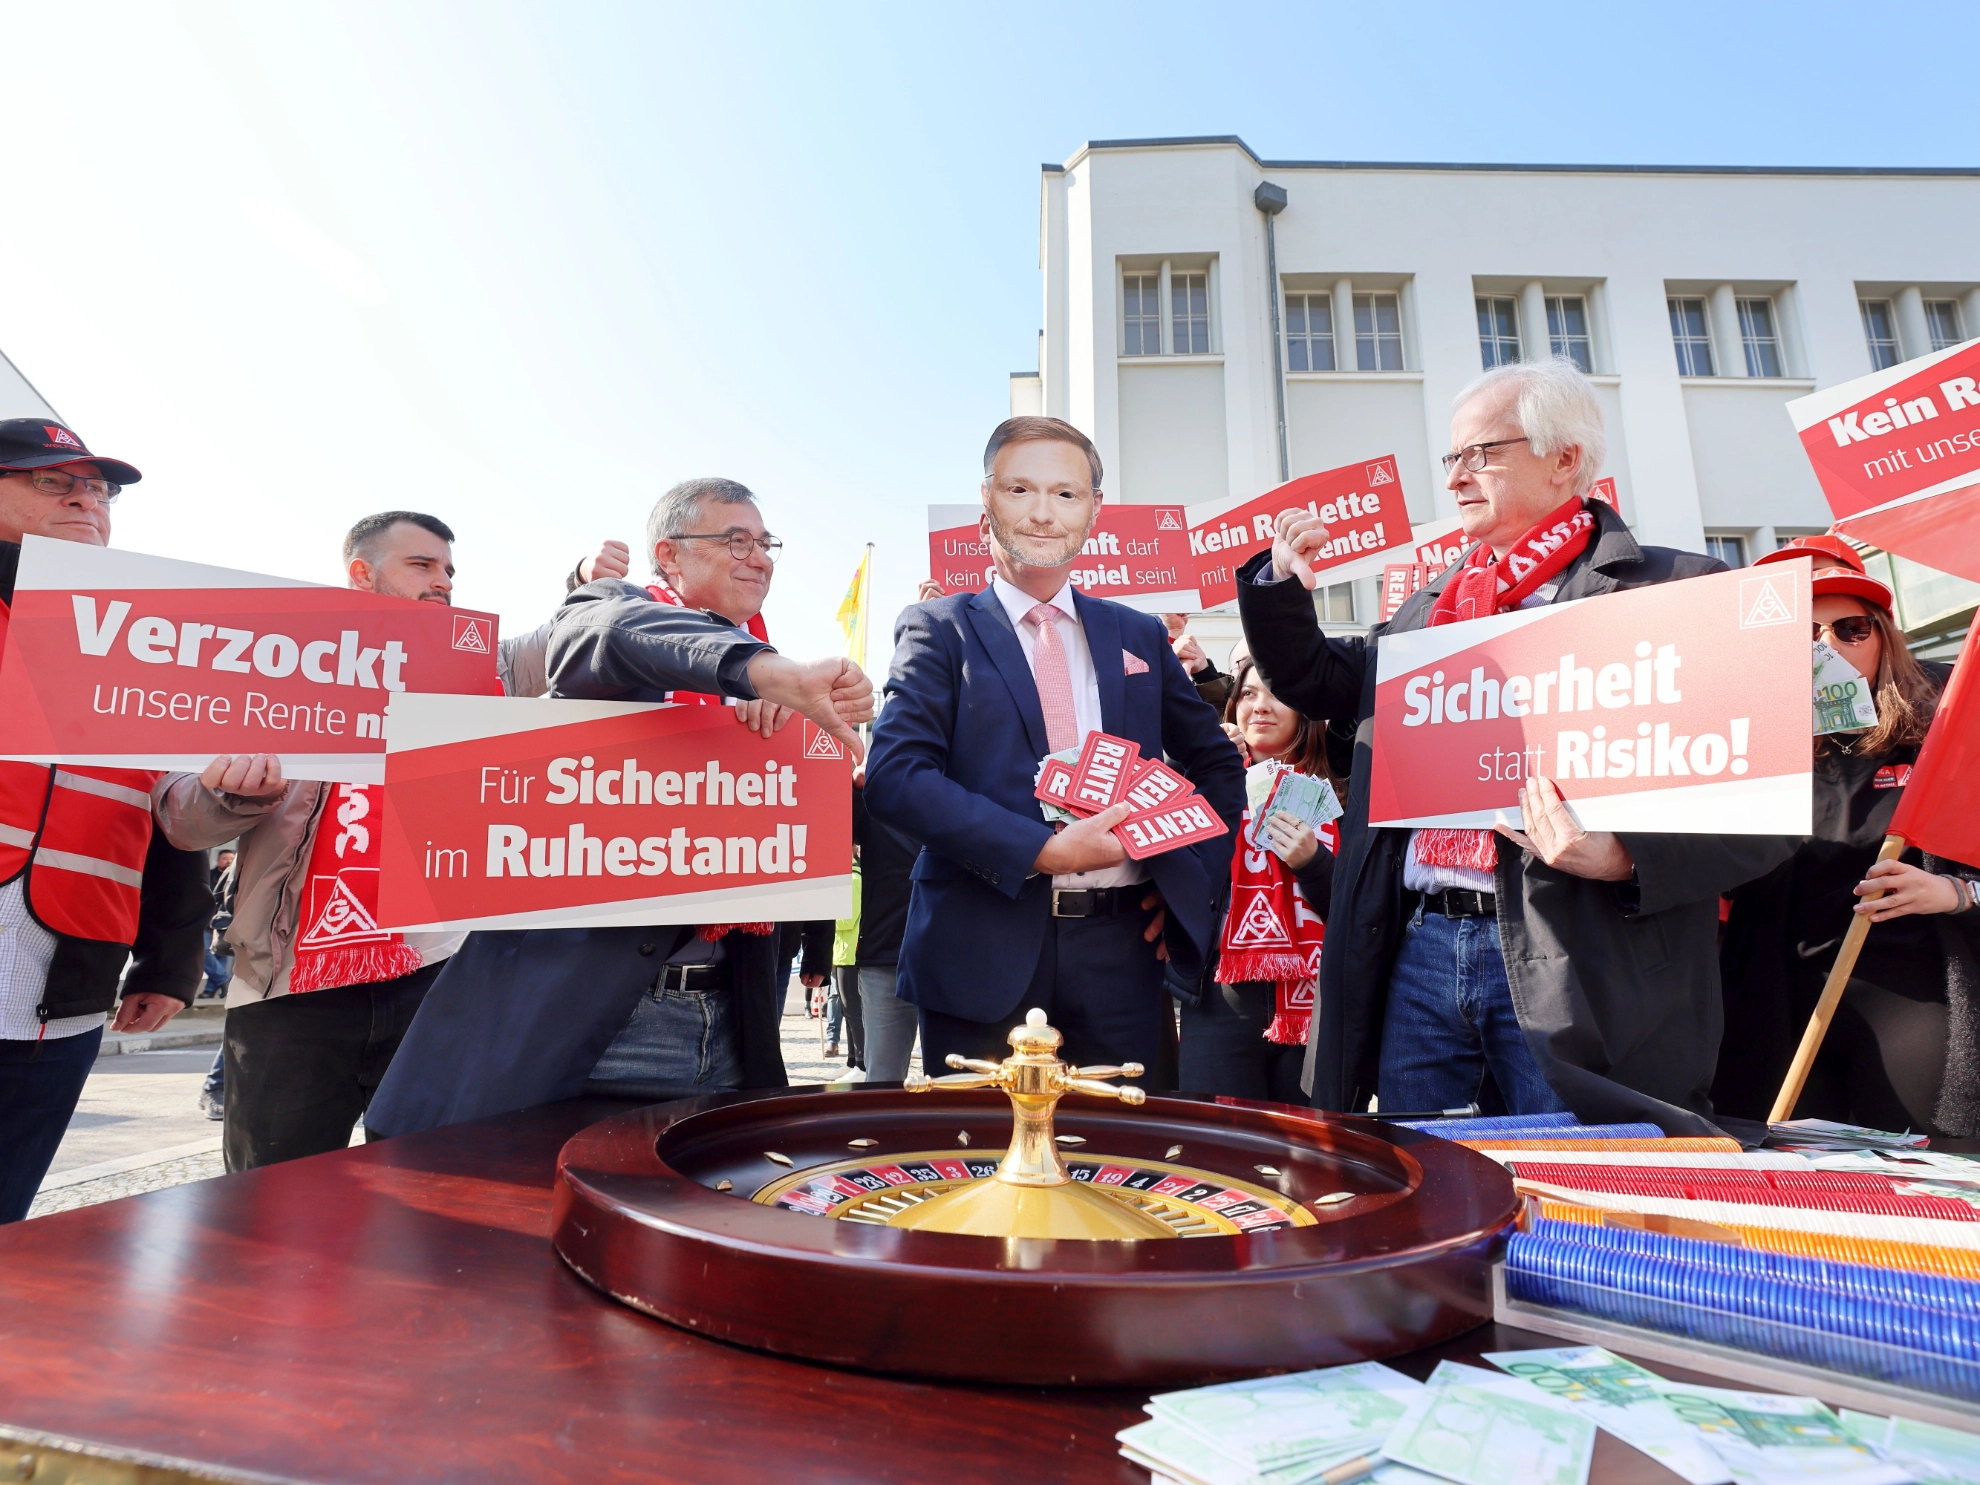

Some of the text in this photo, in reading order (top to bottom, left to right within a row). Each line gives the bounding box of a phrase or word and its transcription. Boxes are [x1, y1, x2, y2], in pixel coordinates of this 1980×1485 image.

[1827, 397, 1939, 447] Kein
[1863, 449, 1914, 479] mit
[1188, 492, 1381, 556] Kein Rlette
[1314, 522, 1386, 561] ente!
[1126, 538, 1159, 555] darf
[1420, 535, 1478, 567] Nei
[945, 569, 980, 587] kein
[1135, 566, 1177, 585] sein!
[1201, 565, 1229, 587] mit
[71, 594, 407, 692] Verzockt
[1402, 640, 1682, 727] Sicherheit
[1822, 681, 1858, 702] 100
[93, 684, 232, 725] unsere
[243, 692, 346, 736] Rente
[1477, 717, 1750, 781] statt Risiko!
[480, 755, 798, 807] Für Sicherheit
[1079, 740, 1126, 806] RENTE
[1124, 769, 1179, 812] REN
[1125, 805, 1214, 848] RENTE
[425, 823, 808, 879] im Ruhestand!
[835, 1182, 860, 1194] 7
[853, 1175, 886, 1190] 28
[884, 1171, 911, 1184] 12
[910, 1168, 938, 1180] 35
[945, 1166, 962, 1178] 3
[971, 1165, 996, 1177] 26
[1071, 1169, 1091, 1180] 15
[1099, 1172, 1123, 1184] 19
[1130, 1177, 1149, 1188] 4
[1153, 1181, 1184, 1194] 21
[1182, 1189, 1208, 1200] 2
[1201, 1195, 1236, 1207] 25
